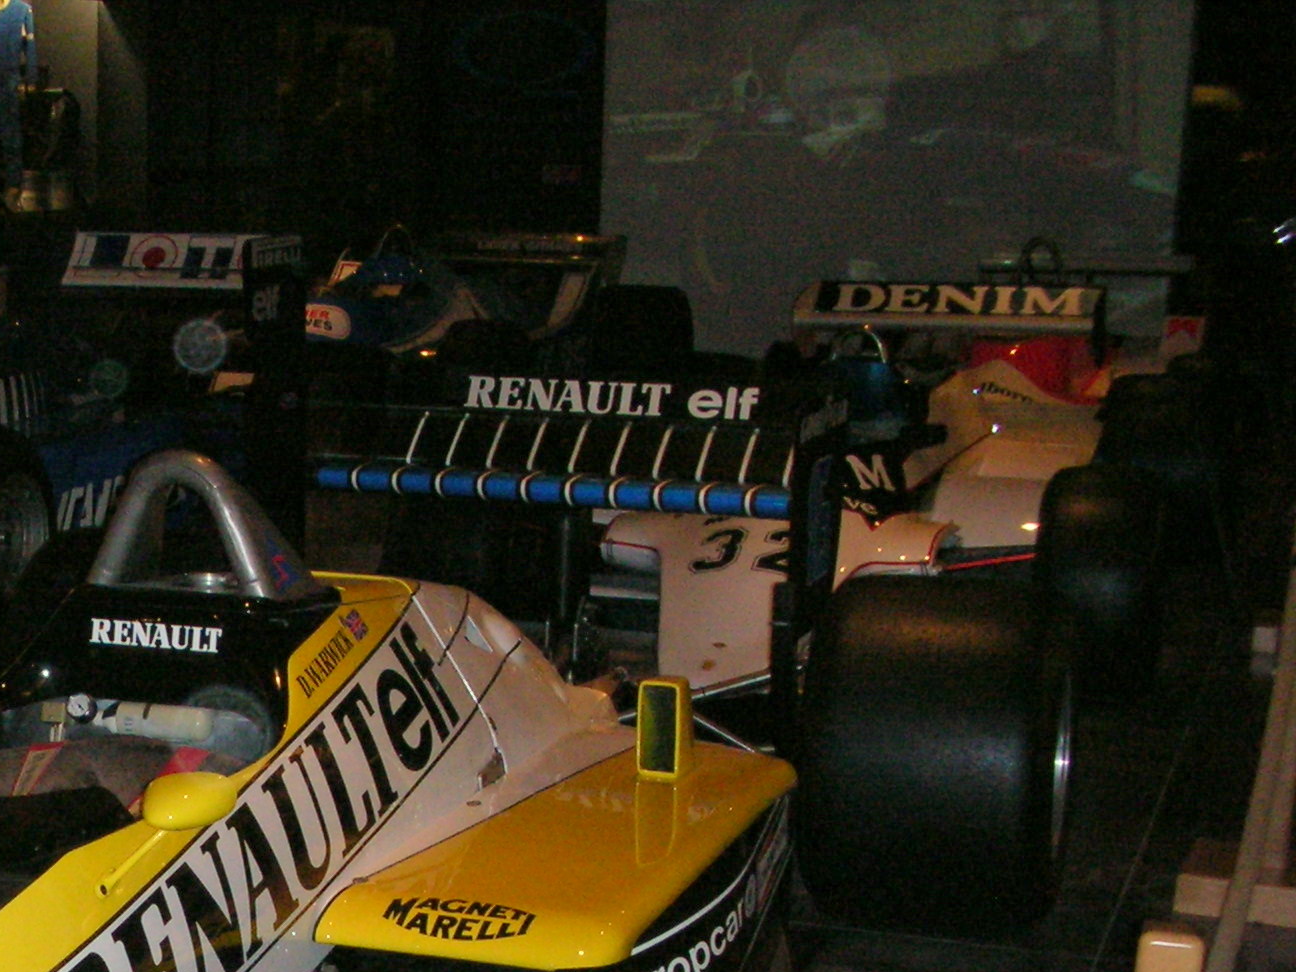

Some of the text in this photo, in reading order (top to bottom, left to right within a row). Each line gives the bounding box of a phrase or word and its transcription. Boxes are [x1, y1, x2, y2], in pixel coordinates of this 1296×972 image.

[70, 234, 244, 281] LOT
[831, 282, 1088, 317] DENIM
[463, 374, 761, 421] RENAULT elf
[89, 617, 223, 655] RENAULT
[376, 621, 460, 771] elf
[383, 897, 536, 924] MAGNETI
[388, 908, 536, 941] MARELLI
